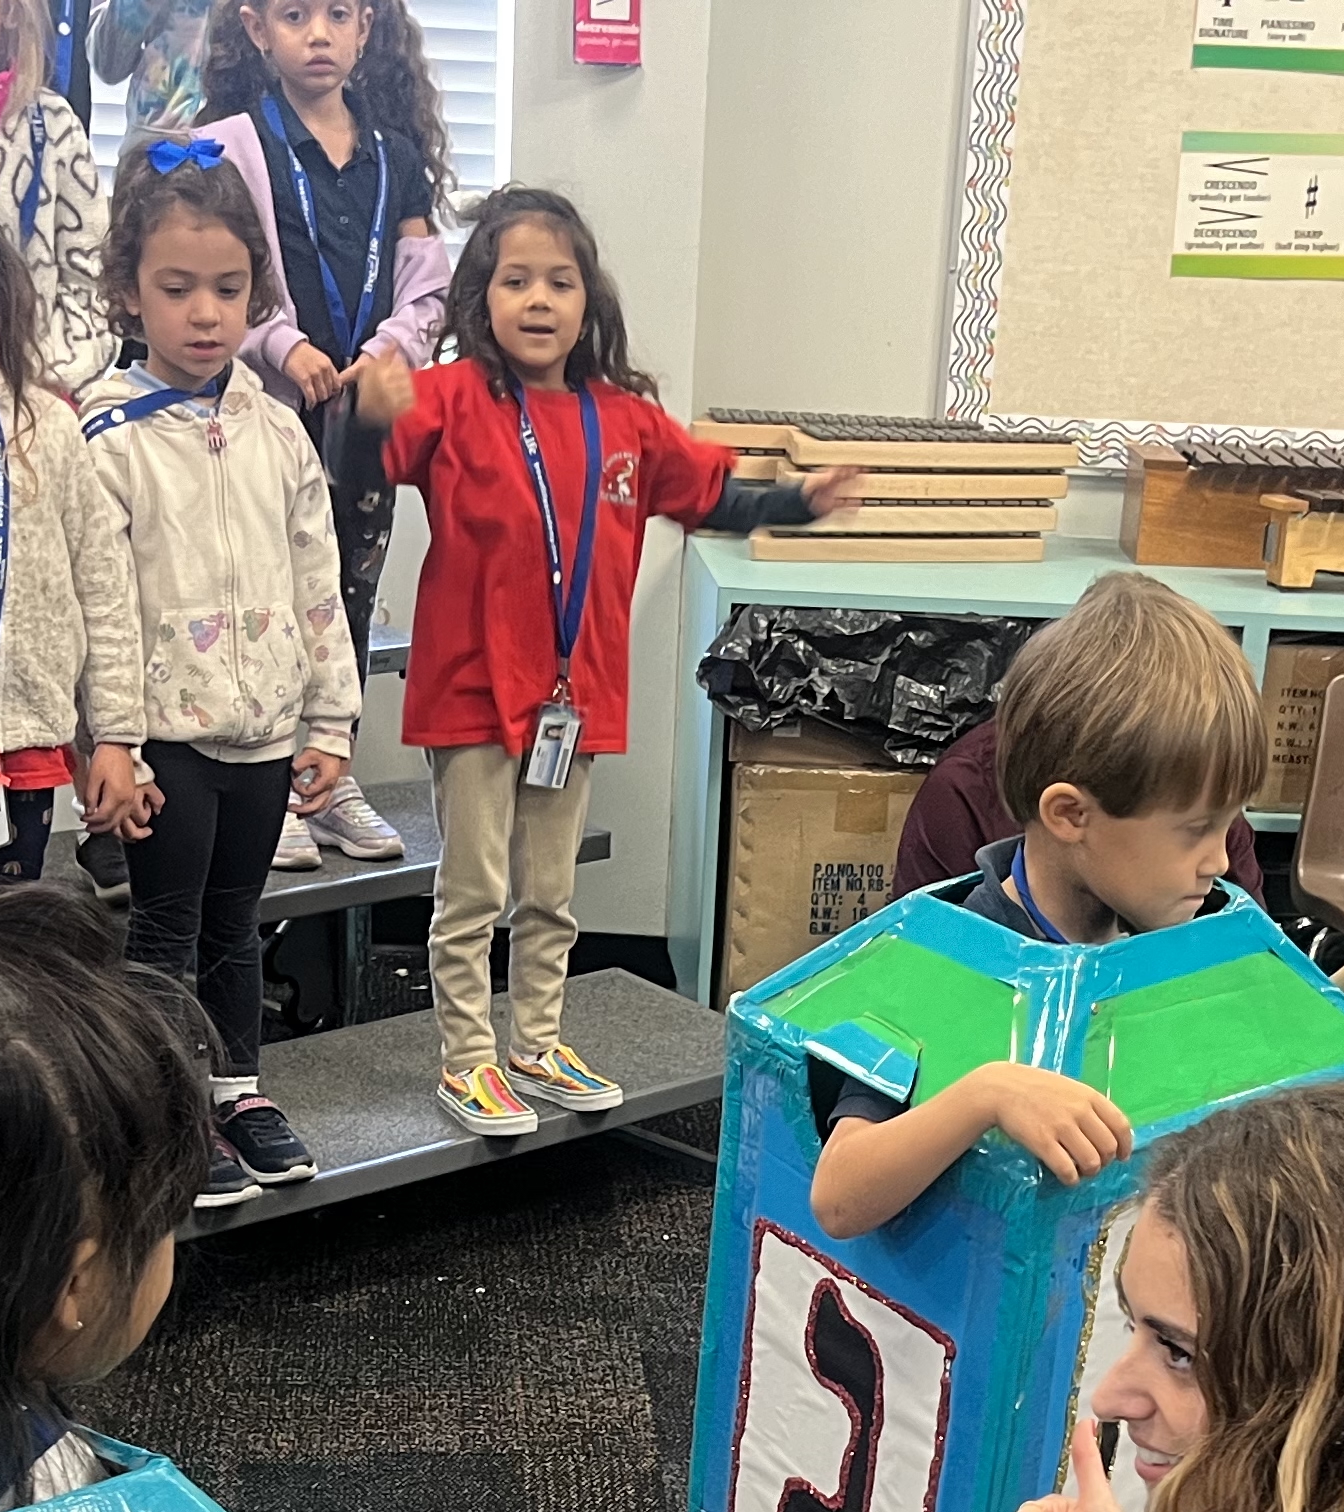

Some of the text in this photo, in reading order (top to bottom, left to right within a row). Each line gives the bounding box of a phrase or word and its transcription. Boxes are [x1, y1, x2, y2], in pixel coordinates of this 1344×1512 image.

[522, 428, 538, 456] Life
[1280, 687, 1309, 698] ITEM
[812, 877, 841, 892] ITEM
[857, 892, 866, 906] 4
